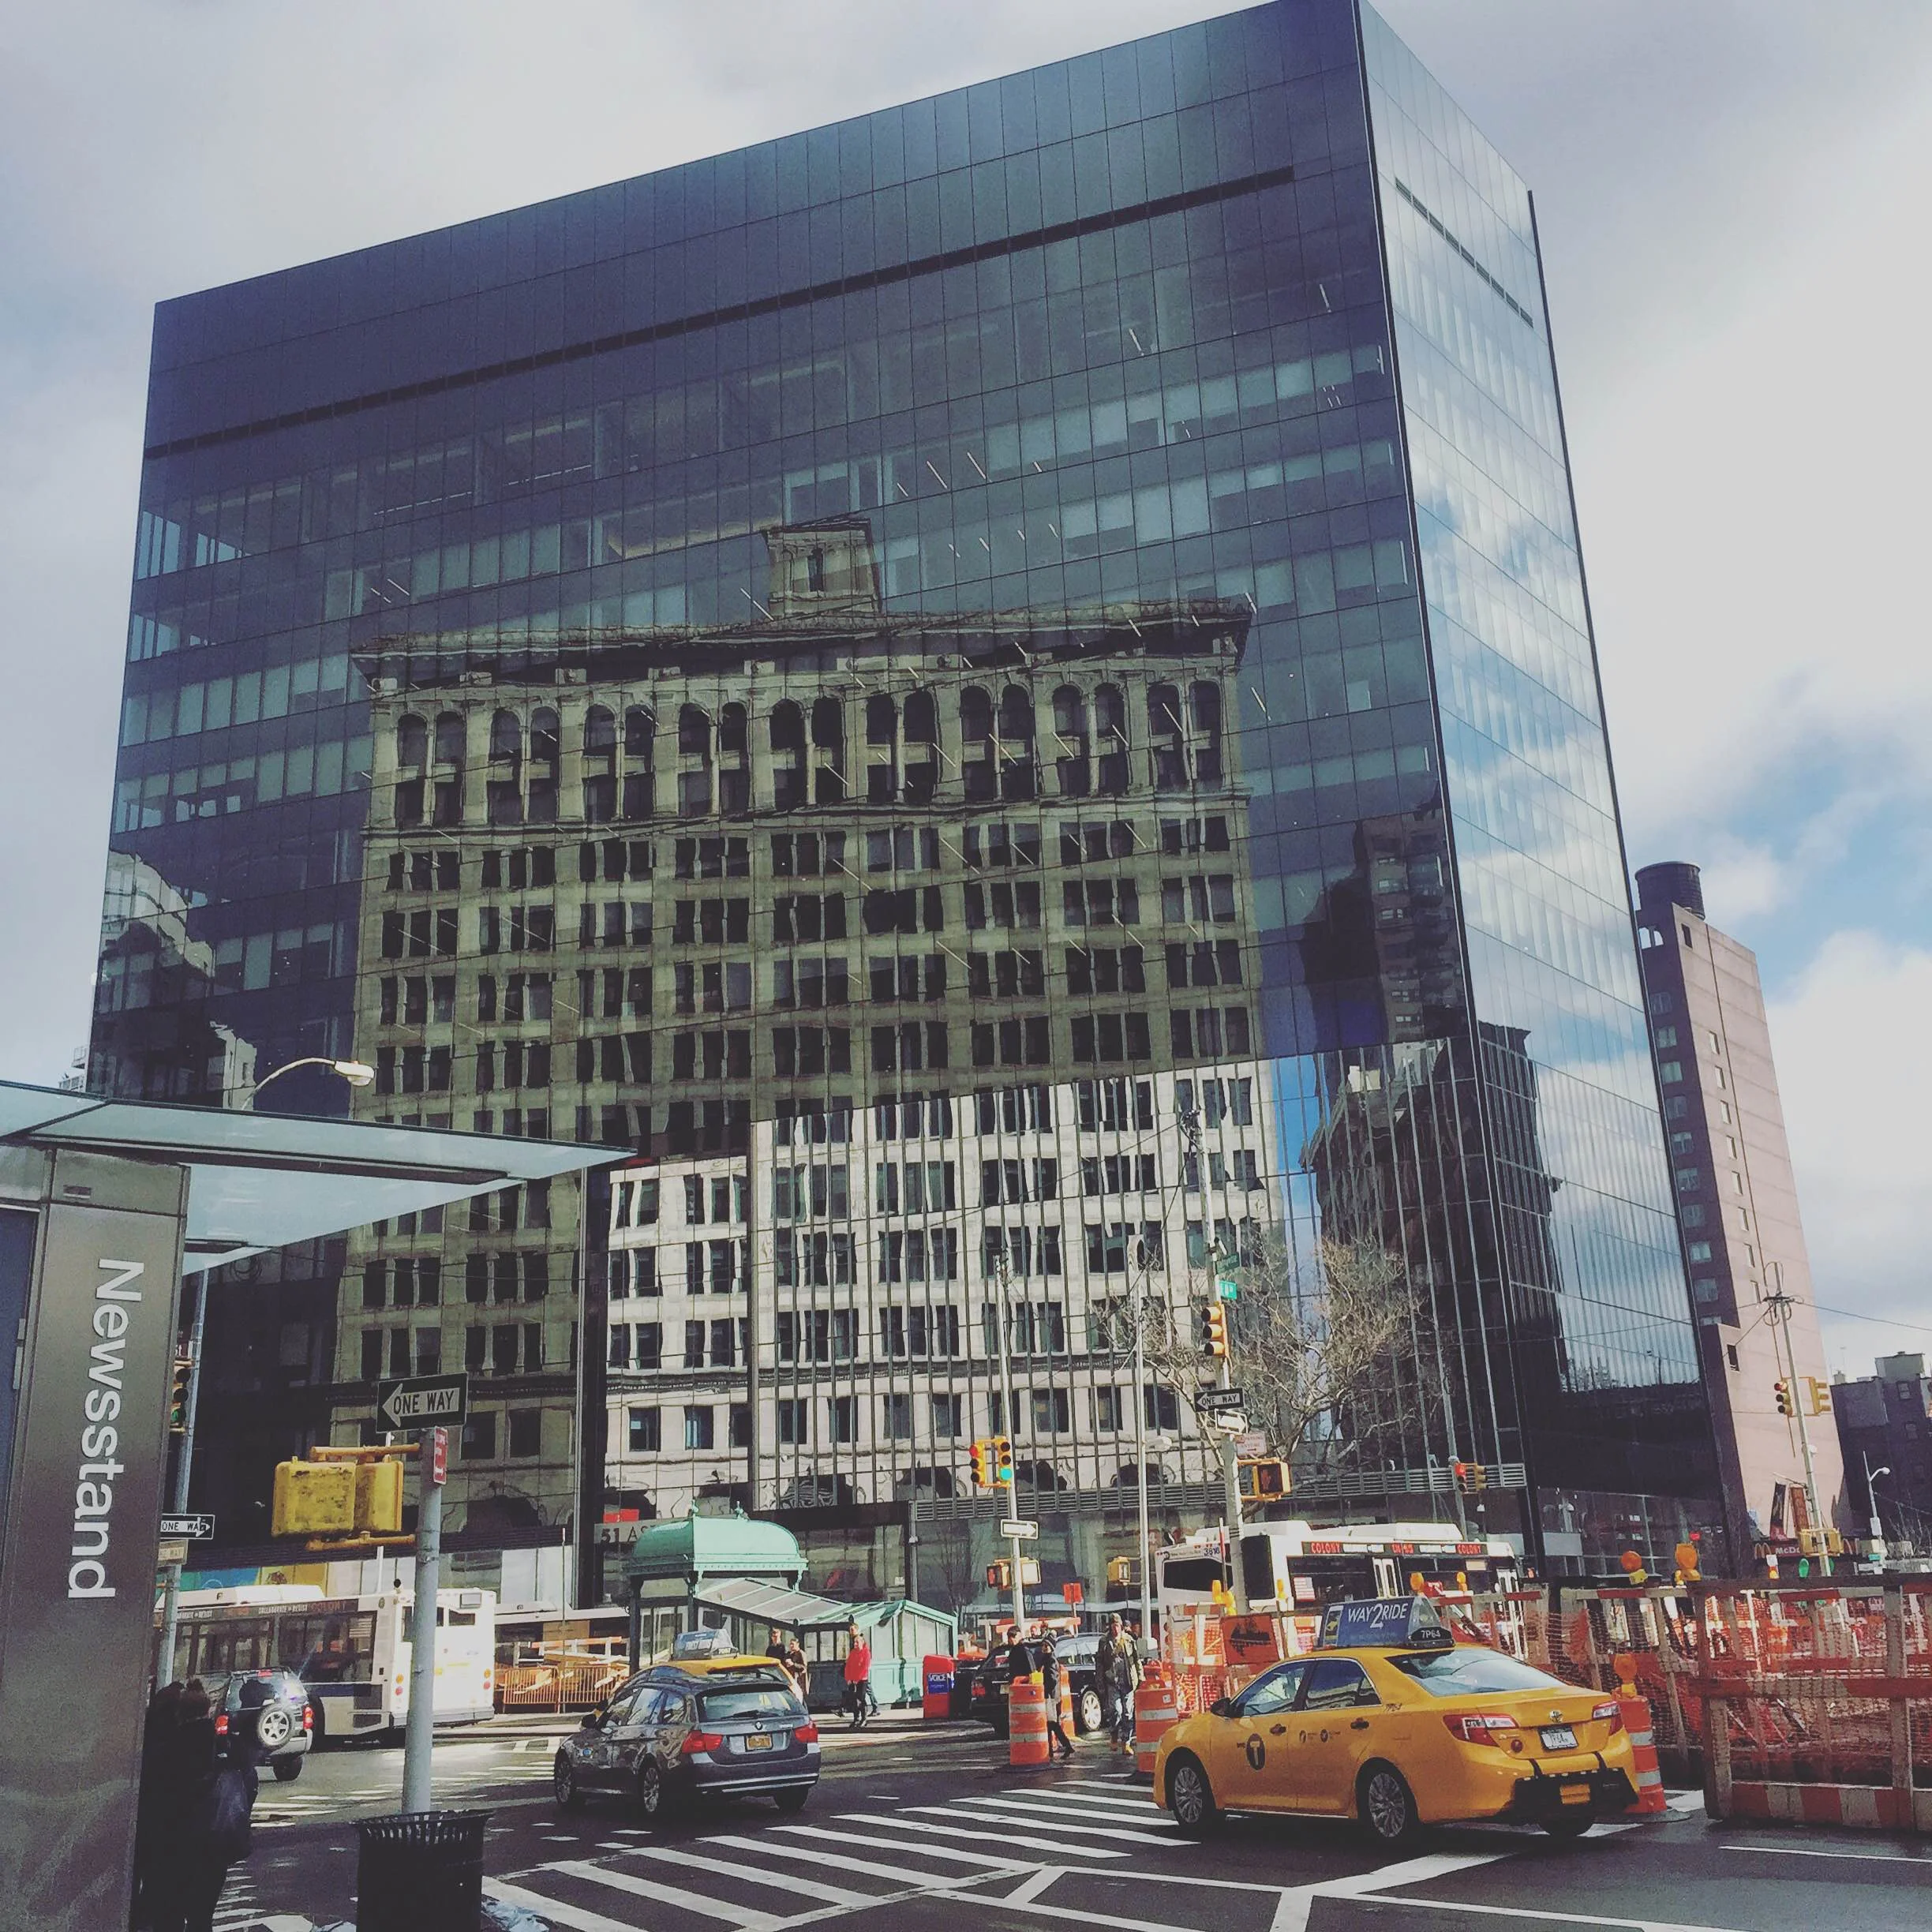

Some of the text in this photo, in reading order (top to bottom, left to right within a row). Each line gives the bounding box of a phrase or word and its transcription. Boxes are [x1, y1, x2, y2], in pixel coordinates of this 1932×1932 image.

[393, 1390, 455, 1415] ONE WAY
[1201, 1395, 1237, 1406] ONE WAY
[68, 1258, 144, 1599] Newsstand
[162, 1522, 179, 1531] ONE
[600, 1527, 620, 1544] 51
[1311, 1543, 1341, 1555] COLONY
[1456, 1544, 1481, 1555] COLONY
[1348, 1603, 1409, 1630] WAY2RIDE
[1421, 1630, 1441, 1638] 7P64
